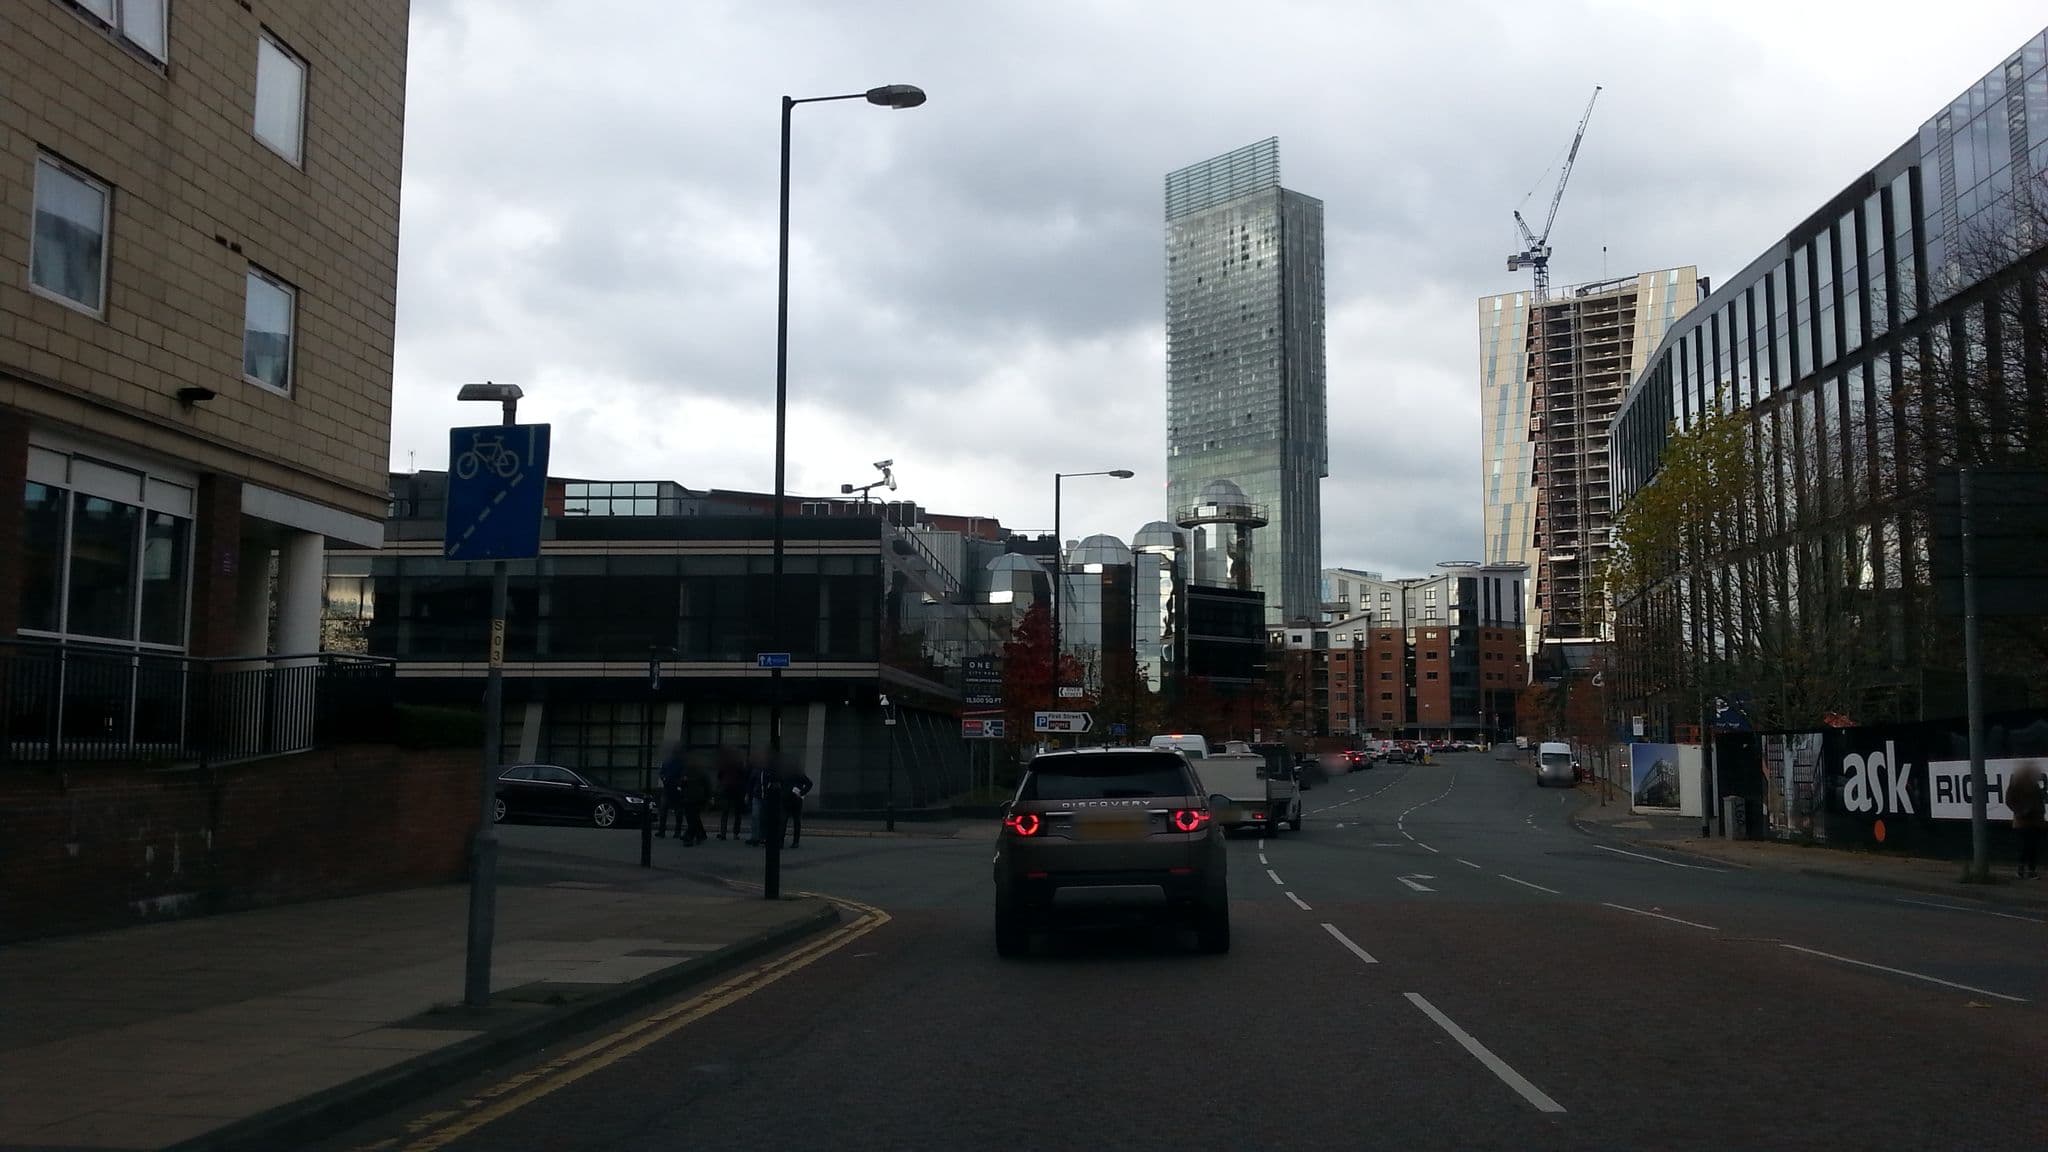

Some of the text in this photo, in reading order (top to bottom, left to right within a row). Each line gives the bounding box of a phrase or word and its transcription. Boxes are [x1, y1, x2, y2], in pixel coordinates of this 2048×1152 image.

[968, 661, 991, 669] ONE
[1842, 740, 1915, 816] ask
[1062, 800, 1151, 809] DISCOVERY
